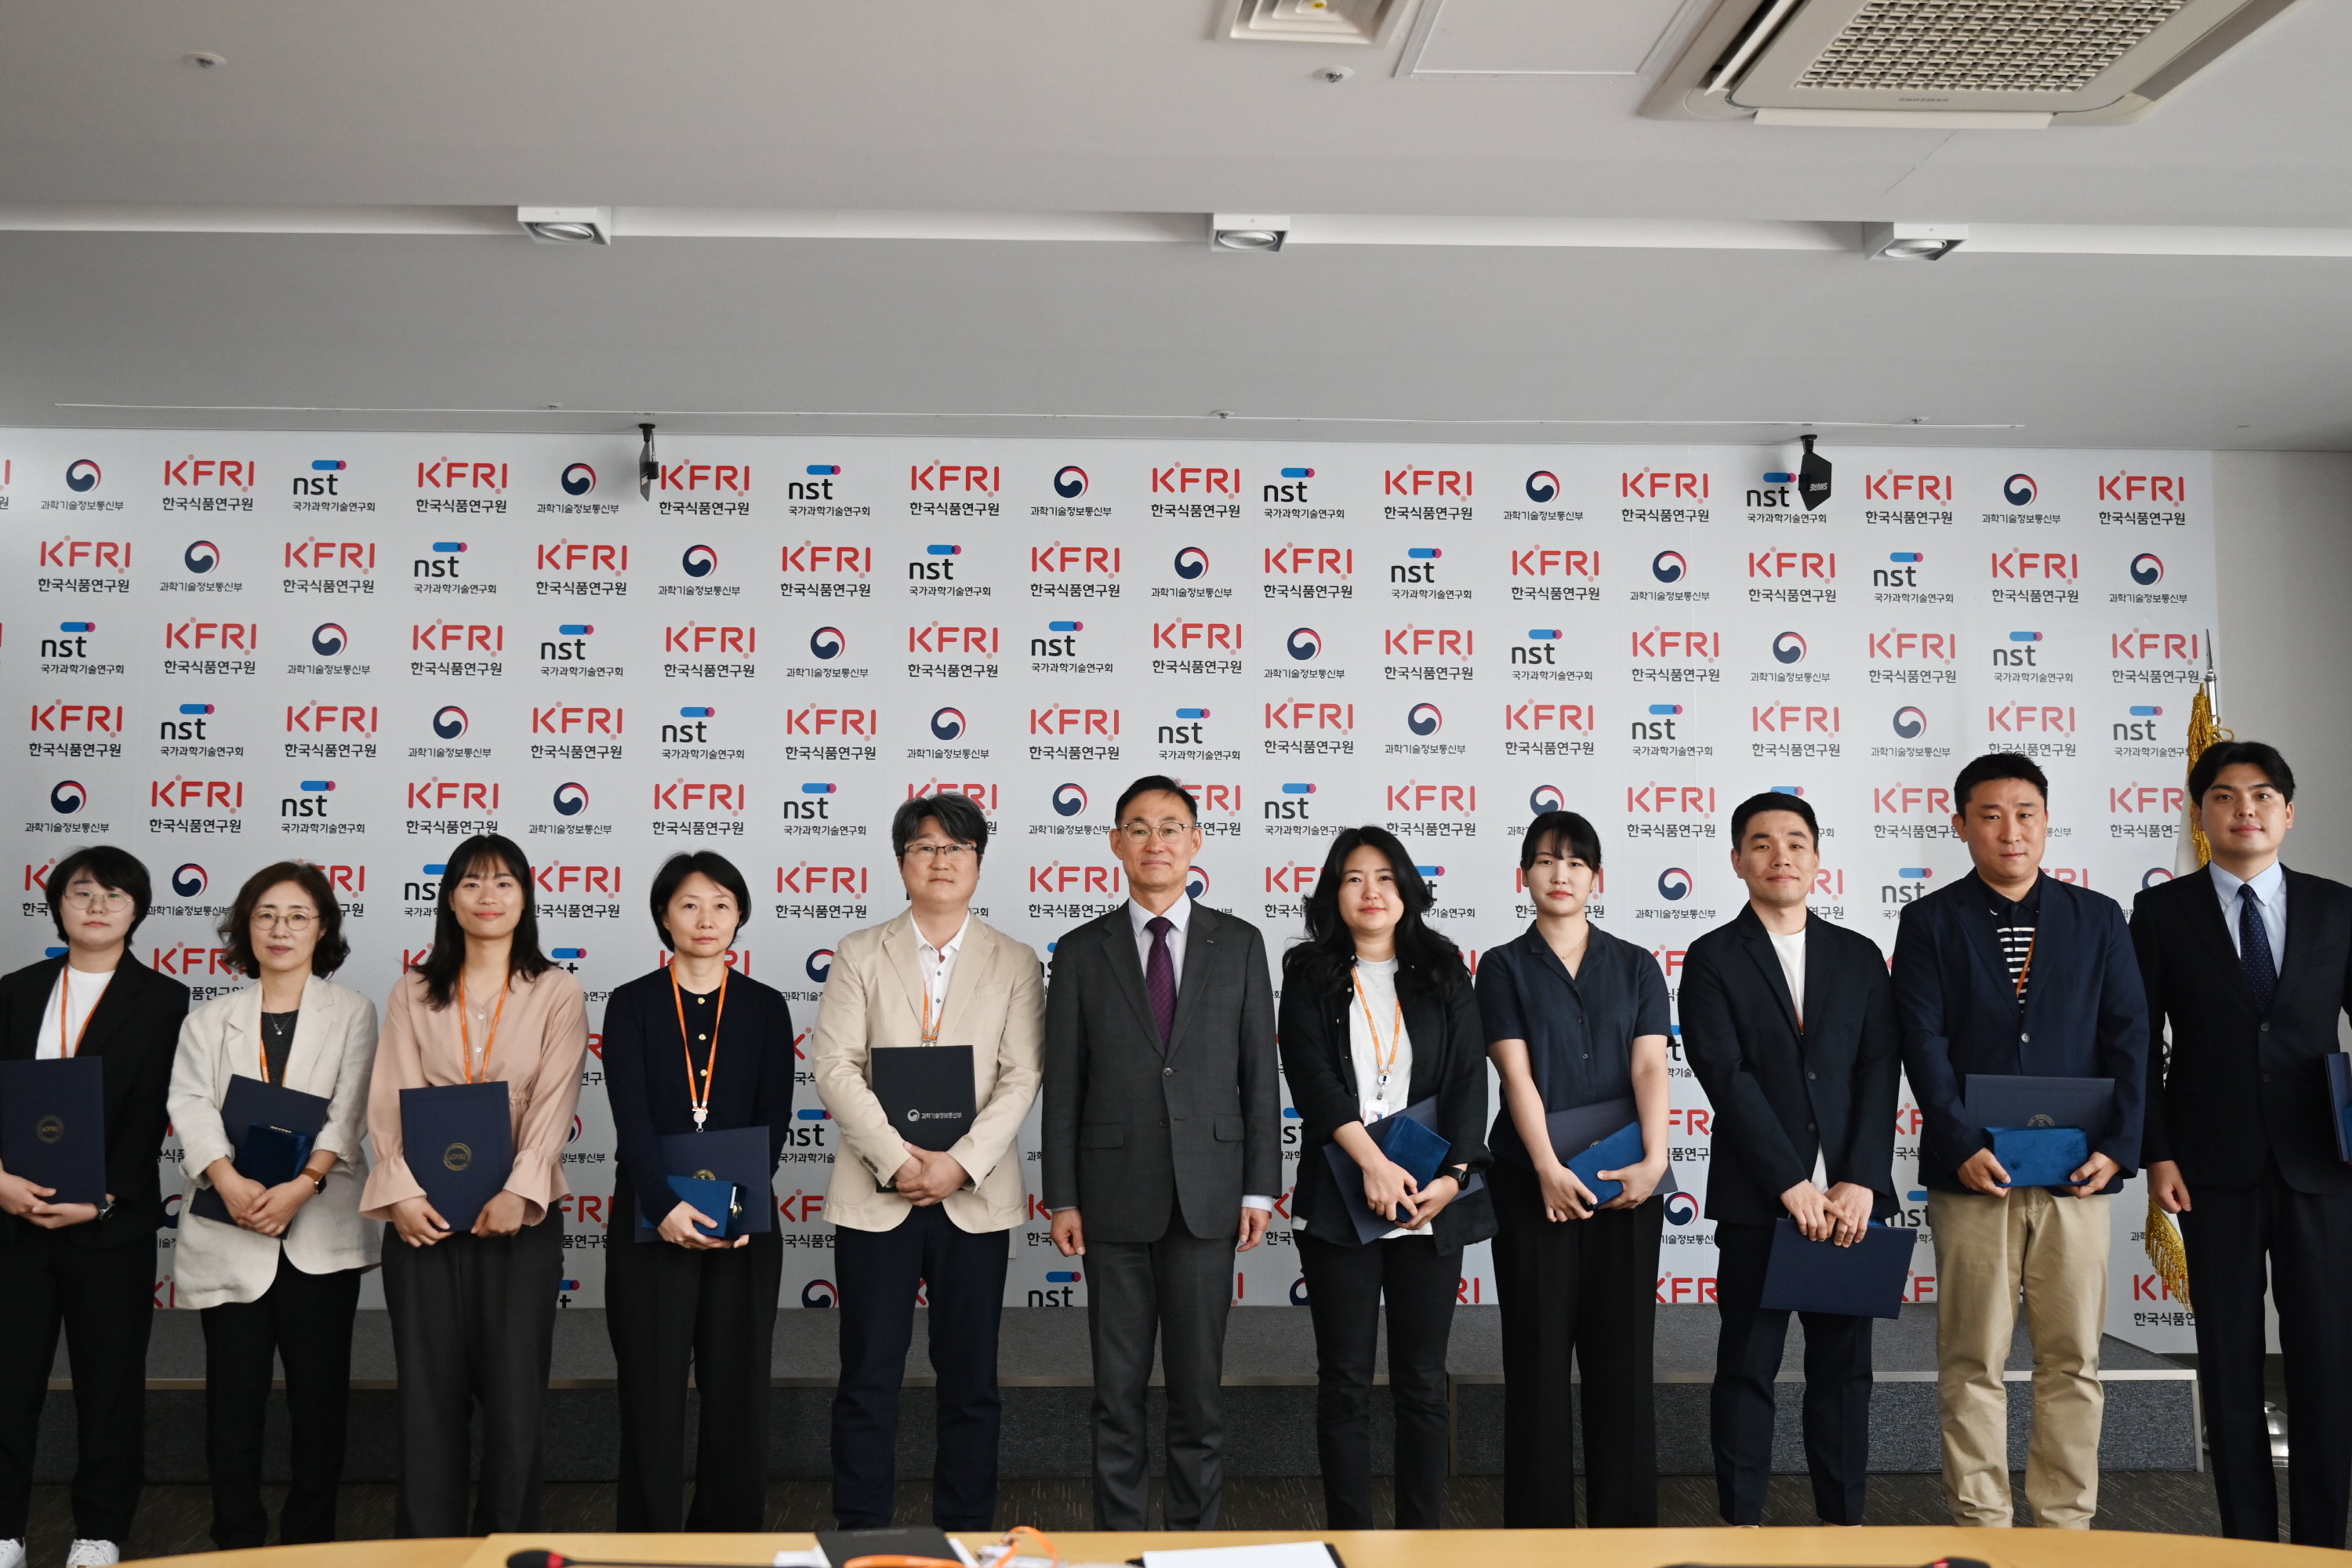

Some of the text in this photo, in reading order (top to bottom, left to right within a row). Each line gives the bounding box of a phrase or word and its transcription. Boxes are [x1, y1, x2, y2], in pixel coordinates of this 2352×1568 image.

[163, 460, 256, 486] KFRI
[417, 462, 509, 488] KFRI
[660, 465, 751, 491] KFRI
[910, 465, 1000, 492] KFRI
[1151, 467, 1241, 494] KFRI
[292, 474, 339, 496] nst
[787, 478, 834, 500] nst
[1385, 470, 1473, 496] KFRI
[1621, 472, 1710, 499] KFRI
[1809, 482, 1828, 492] SHURE
[1865, 474, 1953, 500] KFRI
[2098, 475, 2186, 502] KFRI
[1262, 481, 1308, 503] nst
[1746, 485, 1791, 509] nst
[40, 500, 125, 511] 과학기술정보통신부
[161, 496, 254, 512] 한국식품연구원
[292, 501, 376, 512] 국가과학기술연구회
[415, 499, 508, 514] 한국식품연구원
[535, 503, 620, 514] 과학기술정보통신부
[658, 501, 750, 516] 한국식품연구원
[787, 506, 871, 517] 국가과학기술연구회
[909, 501, 1000, 517] 한국식품연구원
[1029, 506, 1112, 517] 과학기술정보통신부
[1149, 503, 1241, 518] 한국식품연구원
[1262, 508, 1345, 520] 국가과학기술연구회
[1383, 506, 1473, 521] 한국식품연구원
[1502, 510, 1584, 521] 과학기술정보통신부
[1620, 508, 1710, 523] 한국식품연구원
[1746, 513, 1828, 524] 국가과학기술연구회
[1864, 510, 1954, 525] 한국식품연구원
[1981, 514, 2062, 524] 과학기술정보통신부
[2097, 510, 2187, 526] 한국식품연구원
[39, 541, 132, 568] KFRI
[285, 543, 376, 568] KFRI
[537, 544, 629, 571] KFRI
[781, 546, 872, 572] KFRI
[1030, 546, 1121, 573] KFRI
[1264, 548, 1353, 575] KFRI
[412, 555, 460, 579] nst
[908, 558, 955, 581] nst
[1512, 550, 1600, 576] KFRI
[1748, 552, 1836, 579] KFRI
[1991, 553, 2078, 579] KFRI
[1389, 561, 1436, 584] nst
[1872, 565, 1918, 588] nst
[37, 578, 130, 593] 한국식품연구원
[158, 581, 244, 593] 과학기술정보통신부
[281, 579, 375, 593] 한국식품연구원
[412, 583, 498, 594] 국가과학기술연구회
[535, 580, 628, 596] 한국식품연구원
[657, 585, 742, 597] 과학기술정보통신부
[779, 583, 872, 597] 한국식품연구원
[908, 586, 992, 597] 국가과학기술연구회
[1029, 583, 1121, 598] 한국식품연구원
[1149, 587, 1233, 598] 과학기술정보통신부
[1262, 584, 1353, 599] 한국식품연구원
[1390, 589, 1473, 600] 국가과학기술연구회
[1510, 586, 1601, 601] 한국식품연구원
[1629, 590, 1711, 602] 과학기술정보통신부
[1747, 588, 1837, 603] 한국식품연구원
[1873, 593, 1955, 604] 국가과학기술연구회
[1991, 589, 2080, 604] 한국식품연구원
[2107, 593, 2189, 604] 과학기술정보통신부
[165, 622, 258, 649] KFRI
[412, 624, 504, 652] KFRI
[665, 626, 757, 653] KFRI
[909, 626, 1000, 653] KFRI
[1152, 622, 1243, 649] KFRI
[1385, 629, 1474, 655] KFRI
[40, 636, 89, 659] nst
[539, 638, 587, 661] nst
[1030, 634, 1076, 657] nst
[1632, 631, 1720, 658] KFRI
[1869, 633, 1956, 659] KFRI
[2112, 633, 2198, 659] KFRI
[1510, 643, 1556, 665] nst
[1992, 644, 2038, 667] nst
[39, 663, 125, 675] 국가과학기술연구회
[163, 659, 256, 675] 한국식품연구원
[286, 664, 372, 676] 과학기술정보통신부
[409, 661, 503, 677] 한국식품연구원
[539, 666, 624, 677] 국가과학기술연구회
[662, 663, 756, 678] 한국식품연구원
[785, 667, 869, 679] 과학기술정보통신부
[906, 663, 999, 678] 한국식품연구원
[1030, 662, 1114, 673] 국가과학기술연구회
[1151, 659, 1243, 674] 한국식품연구원
[1263, 668, 1346, 680] 과학기술정보통신부
[1383, 666, 1474, 681] 한국식품연구원
[1511, 670, 1594, 681] 국가과학기술연구회
[1630, 667, 1721, 682] 한국식품연구원
[1749, 672, 1831, 683] 과학기술정보통신부
[1867, 669, 1958, 684] 한국식품연구원
[1993, 672, 2074, 683] 국가과학기술연구회
[2111, 670, 2200, 684] 한국식품연구원
[31, 705, 124, 732] KFRI
[286, 706, 379, 732] KFRI
[532, 707, 624, 734] KFRI
[786, 709, 877, 735] KFRI
[1030, 709, 1120, 735] KFRI
[1265, 702, 1354, 729] KFRI
[1505, 704, 1595, 731] KFRI
[1752, 706, 1840, 732] KFRI
[1989, 706, 2075, 731] KFRI
[159, 717, 208, 741] nst
[661, 720, 708, 743] nst
[1157, 722, 1204, 745] nst
[1631, 718, 1677, 741] nst
[2112, 719, 2158, 742] nst
[27, 742, 122, 757] 한국식품연구원
[159, 746, 245, 757] 국가과학기술연구회
[283, 742, 377, 758] 한국식품연구원
[407, 747, 492, 758] 과학기술정보통신부
[529, 744, 623, 760] 한국식품연구원
[784, 746, 877, 760] 한국식품연구원
[906, 748, 990, 760] 과학기술정보통신부
[1028, 746, 1120, 760] 한국식품연구원
[1263, 739, 1355, 754] 한국식품연구원
[1384, 744, 1467, 755] 과학기술정보통신부
[1504, 741, 1595, 756] 한국식품연구원
[1632, 746, 1714, 757] 국가과학기술연구회
[1751, 742, 1841, 757] 한국식품연구원
[1870, 746, 1951, 757] 과학기술정보통신부
[661, 749, 746, 760] 국가과학기술연구회
[1157, 750, 1241, 760] 국가과학기술연구회
[151, 781, 244, 808] KFRI
[408, 782, 500, 809] KFRI
[654, 783, 745, 810] KFRI
[1387, 785, 1476, 811] KFRI
[1628, 786, 1715, 813] KFRI
[281, 794, 328, 818] nst
[782, 797, 829, 820] nst
[1263, 797, 1310, 820] nst
[24, 822, 111, 833] 과학기술정보통신부
[148, 818, 242, 833] 한국식품연구원
[280, 822, 366, 834] 국가과학기술연구회
[405, 819, 499, 834] 한국식품연구원
[528, 824, 613, 835] 과학기술정보통신부
[652, 821, 745, 836] 한국식품연구원
[782, 825, 867, 837] 국가과학기술연구회
[1028, 824, 1112, 836] 과학기술정보통신부
[1385, 822, 1477, 837] 한국식품연구원
[1625, 823, 1716, 838] 한국식품연구원
[776, 866, 868, 894] KFRI
[1029, 866, 1120, 893] KFRI
[774, 904, 868, 919] 한국식품연구원
[1634, 909, 1716, 920] 과학기술정보통신부
[1027, 1286, 1073, 1308] nst
